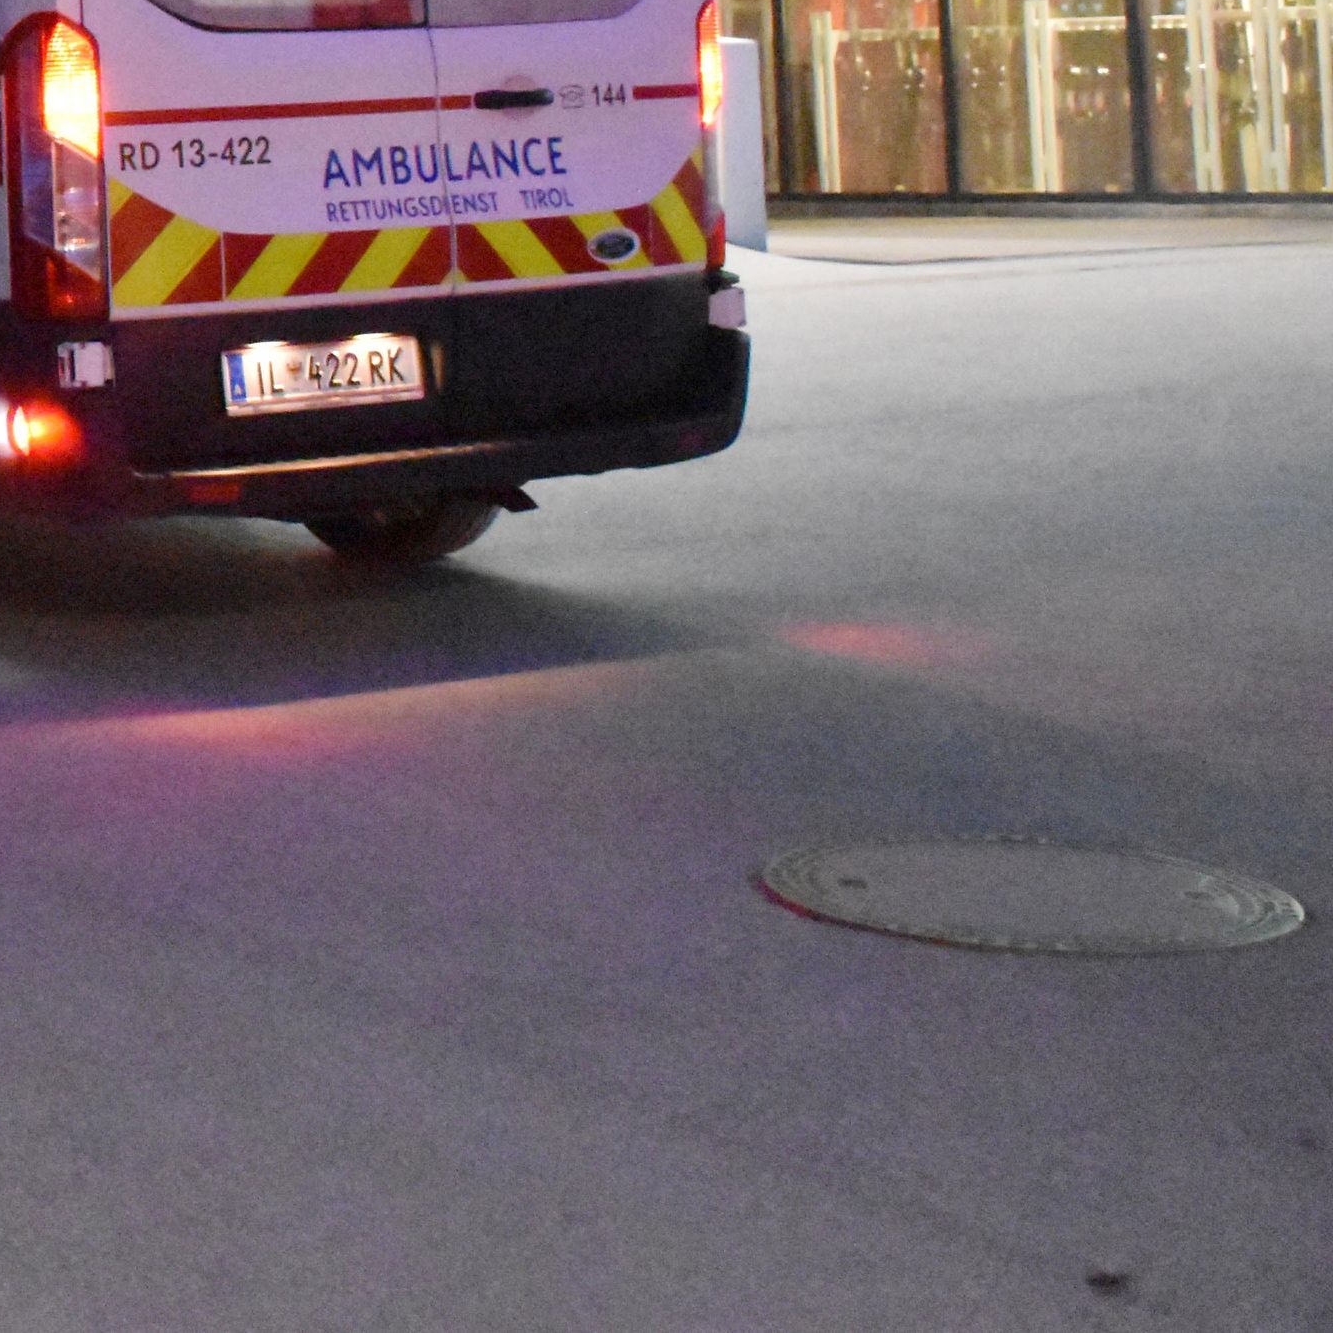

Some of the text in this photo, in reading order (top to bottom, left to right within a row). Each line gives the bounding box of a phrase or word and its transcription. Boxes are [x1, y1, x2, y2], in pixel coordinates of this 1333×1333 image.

[591, 83, 627, 107] 144
[119, 135, 273, 172] RD 13-422
[323, 136, 567, 189] AMBULANCE
[326, 187, 575, 222] RETTUNGSDIENST TIROL
[257, 346, 405, 397] IL 422 RK
